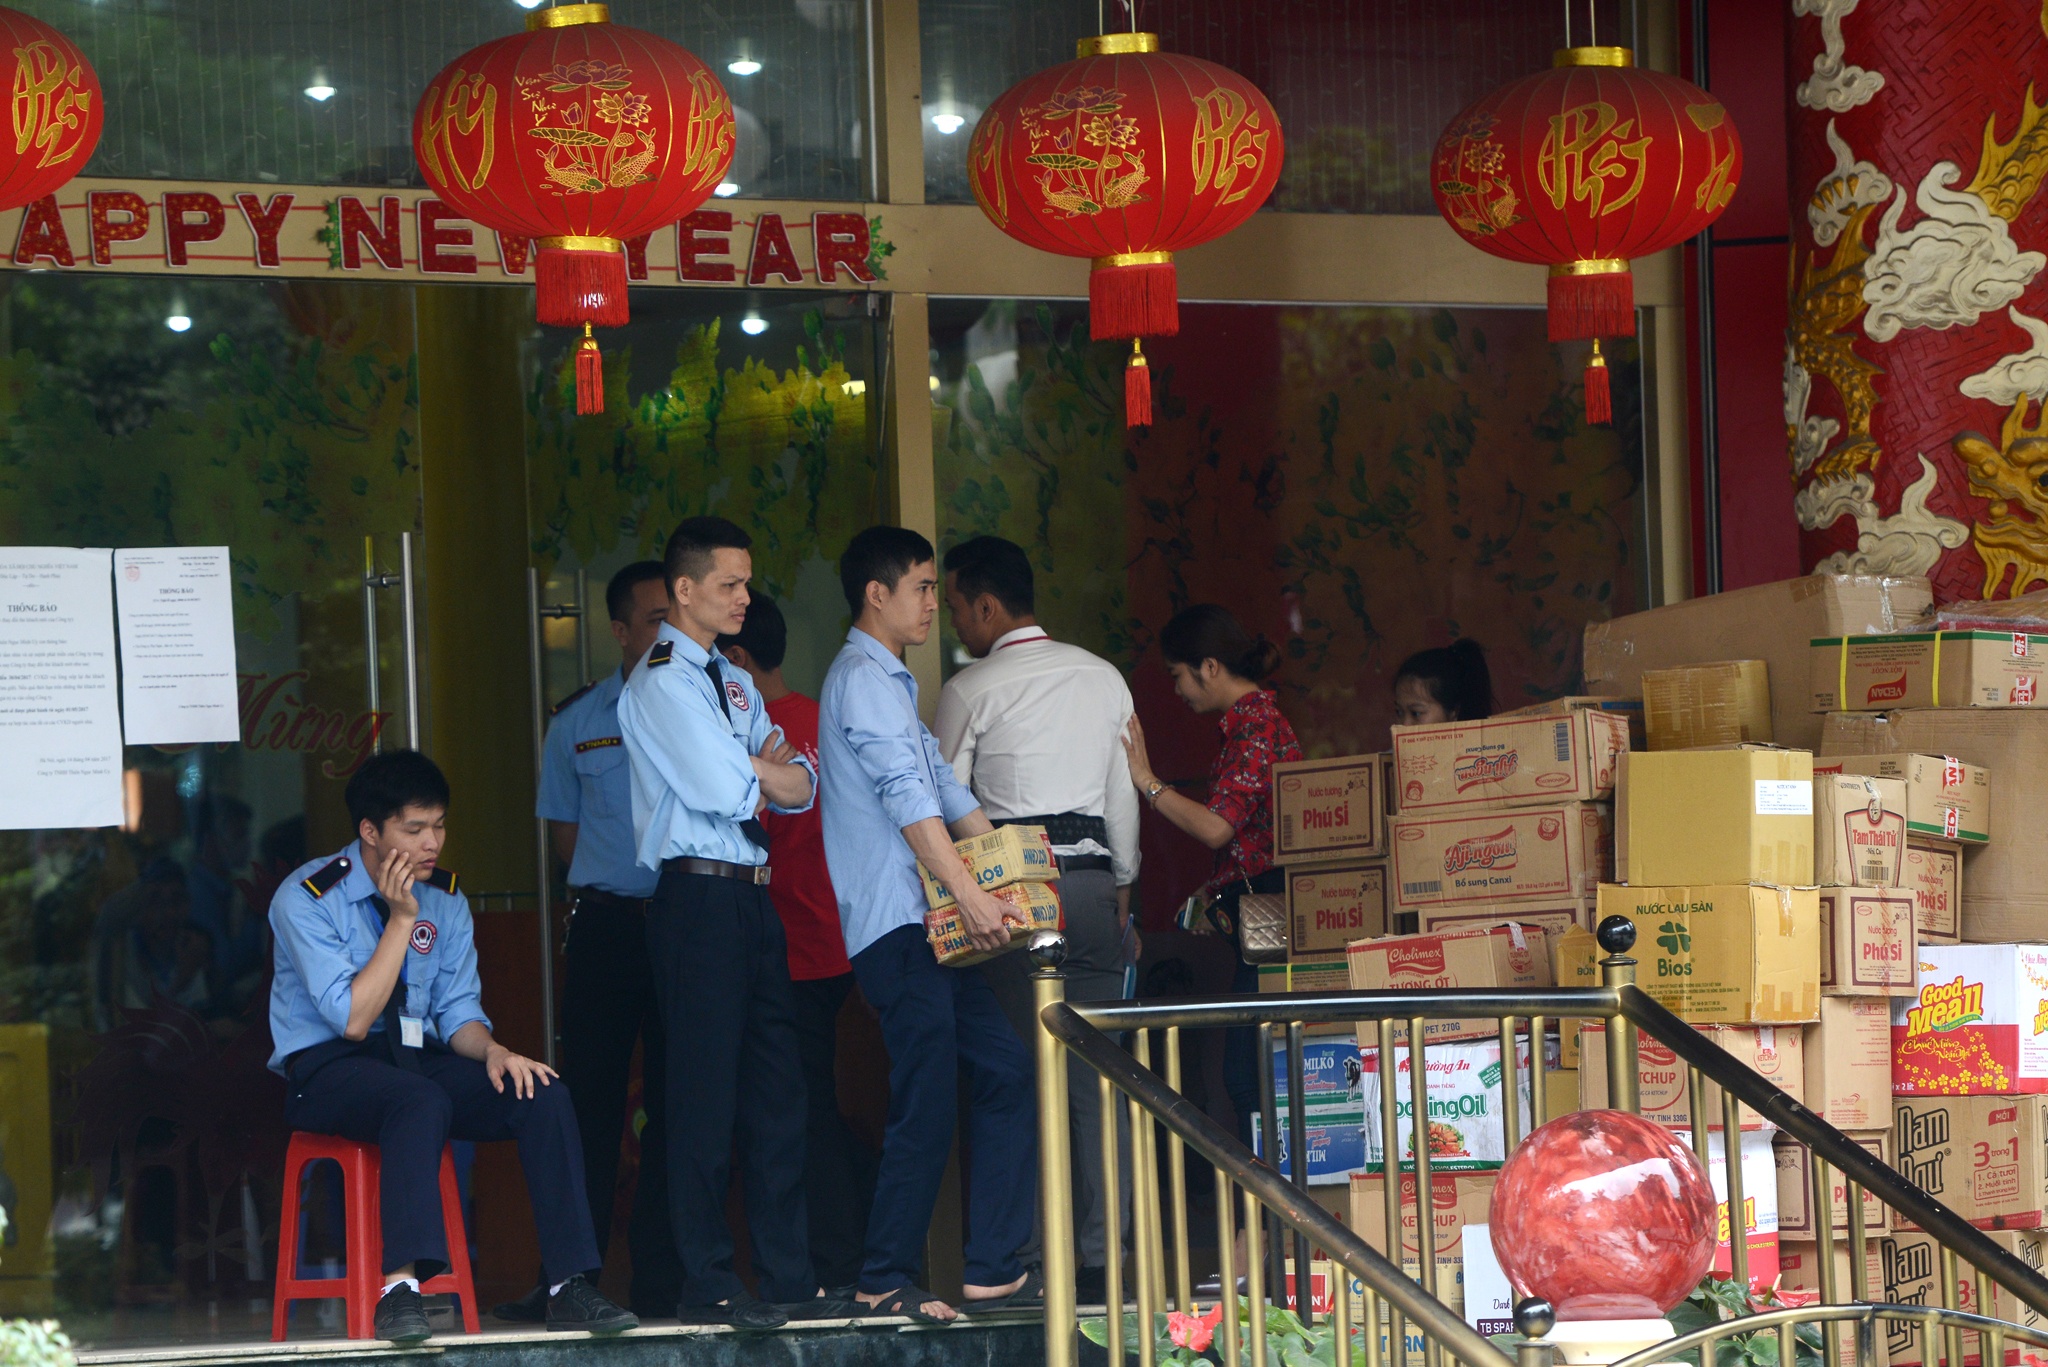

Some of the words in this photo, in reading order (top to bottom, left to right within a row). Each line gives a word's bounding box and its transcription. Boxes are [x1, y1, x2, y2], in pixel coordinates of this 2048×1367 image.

[7, 602, 37, 613] THÔNG
[39, 602, 58, 613] BÁO
[1871, 686, 1903, 698] VEDAN
[1482, 744, 1497, 752] sung
[1302, 805, 1333, 830] Phú
[1853, 829, 1869, 845] Tam
[1869, 829, 1886, 846] Thái
[1886, 829, 1897, 847] Tử
[976, 864, 1004, 885] BỘT
[1467, 879, 1488, 888] sung
[1489, 875, 1512, 885] Canxi
[1636, 903, 1666, 915] NƯỚC
[1668, 902, 1689, 914] LAU
[1691, 900, 1713, 913] SÀN
[1316, 906, 1347, 930] Phú
[1868, 925, 1882, 935] Nước
[944, 934, 972, 952] ANH
[1388, 947, 1443, 964] Cholimex
[1863, 941, 1889, 961] Phú
[1657, 958, 1693, 977] Bios
[1921, 977, 1963, 1006] Good
[1906, 984, 1983, 1038] Meall
[1394, 1030, 1403, 1038] 24
[1425, 1025, 1439, 1034] PET
[1441, 1022, 1461, 1032] 270G
[1303, 1057, 1335, 1071] MILKO
[1425, 1059, 1454, 1075] ường
[1455, 1059, 1471, 1071] An
[1639, 1072, 1677, 1085] TCHUP
[1901, 1082, 1906, 1090] 2
[1906, 1082, 1915, 1090] lít
[1657, 1114, 1671, 1122] TINH
[1672, 1114, 1687, 1122] 330G
[1995, 1111, 2010, 1121] MỚI
[1898, 1105, 1950, 1155] Nam
[1973, 1141, 1991, 1168] 3
[1991, 1147, 2010, 1158] trong
[2008, 1136, 2019, 1162] 1
[1977, 1173, 1985, 1181] 1.
[1986, 1170, 1997, 1180] Cá
[1401, 1180, 1455, 1195] Chmex
[1401, 1214, 1457, 1228] KEHUP
[1437, 1257, 1451, 1265] TINH
[1882, 1238, 1932, 1289] Nam
[1959, 1280, 1970, 1305] 3
[1286, 1295, 1320, 1306] VIN
[1480, 1322, 1492, 1333] TB
